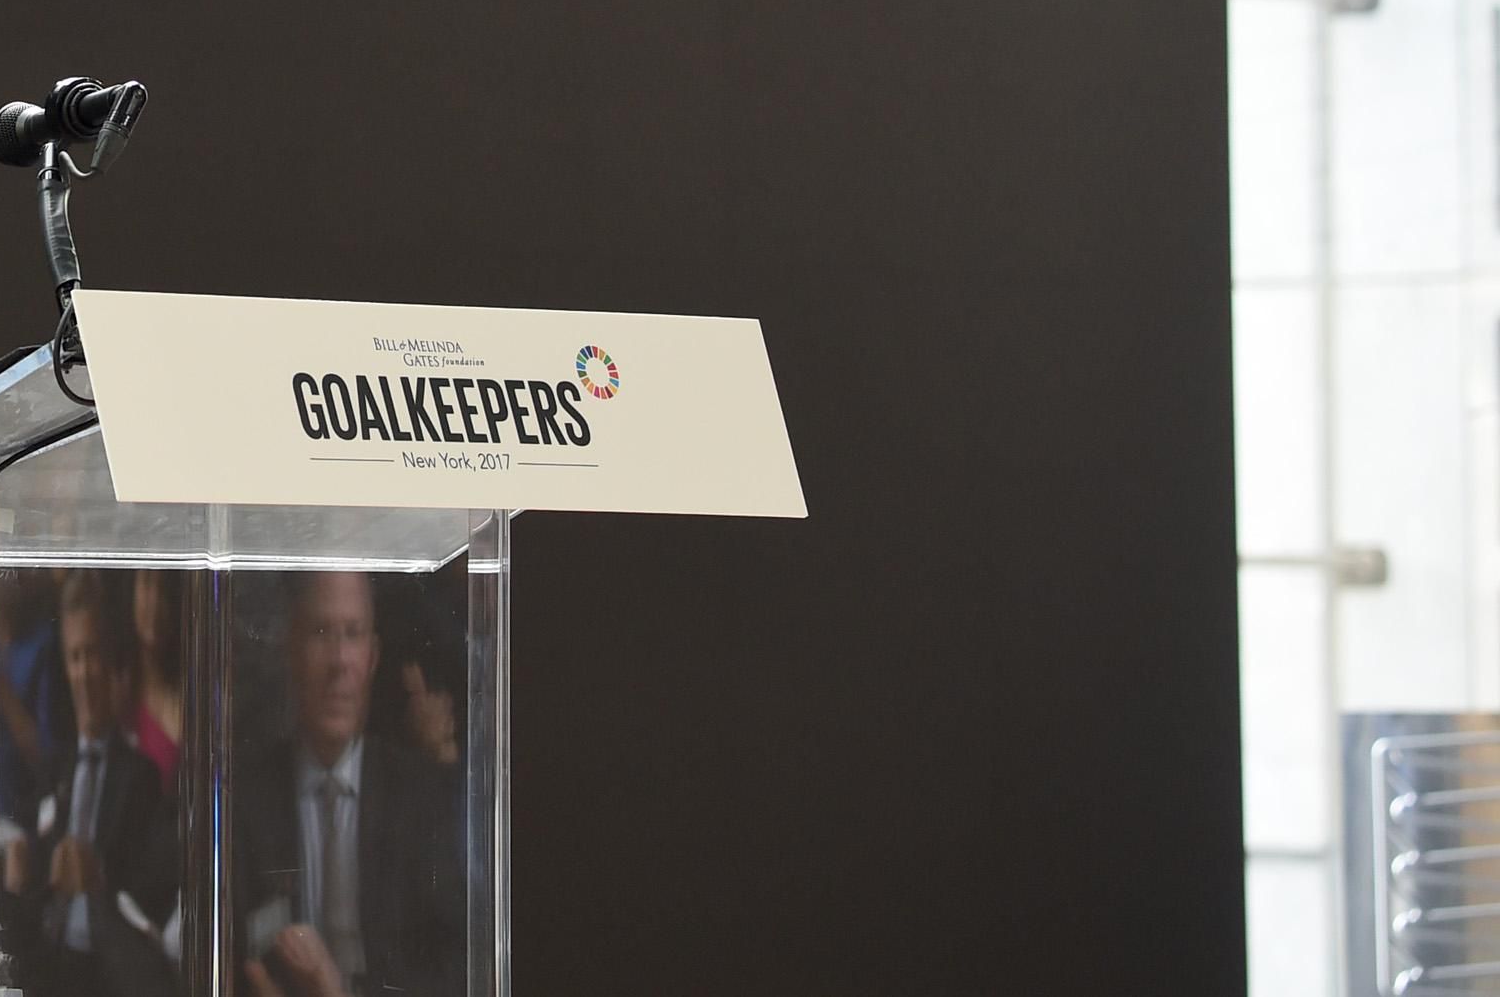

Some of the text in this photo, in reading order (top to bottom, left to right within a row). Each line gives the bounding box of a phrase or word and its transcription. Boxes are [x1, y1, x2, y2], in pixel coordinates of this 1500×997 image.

[373, 337, 399, 351] BILL
[407, 339, 464, 353] MELINDA
[403, 353, 485, 367] GATES foundation
[292, 371, 592, 447] GOALKEEPERS
[402, 451, 510, 472] New York, 2017
